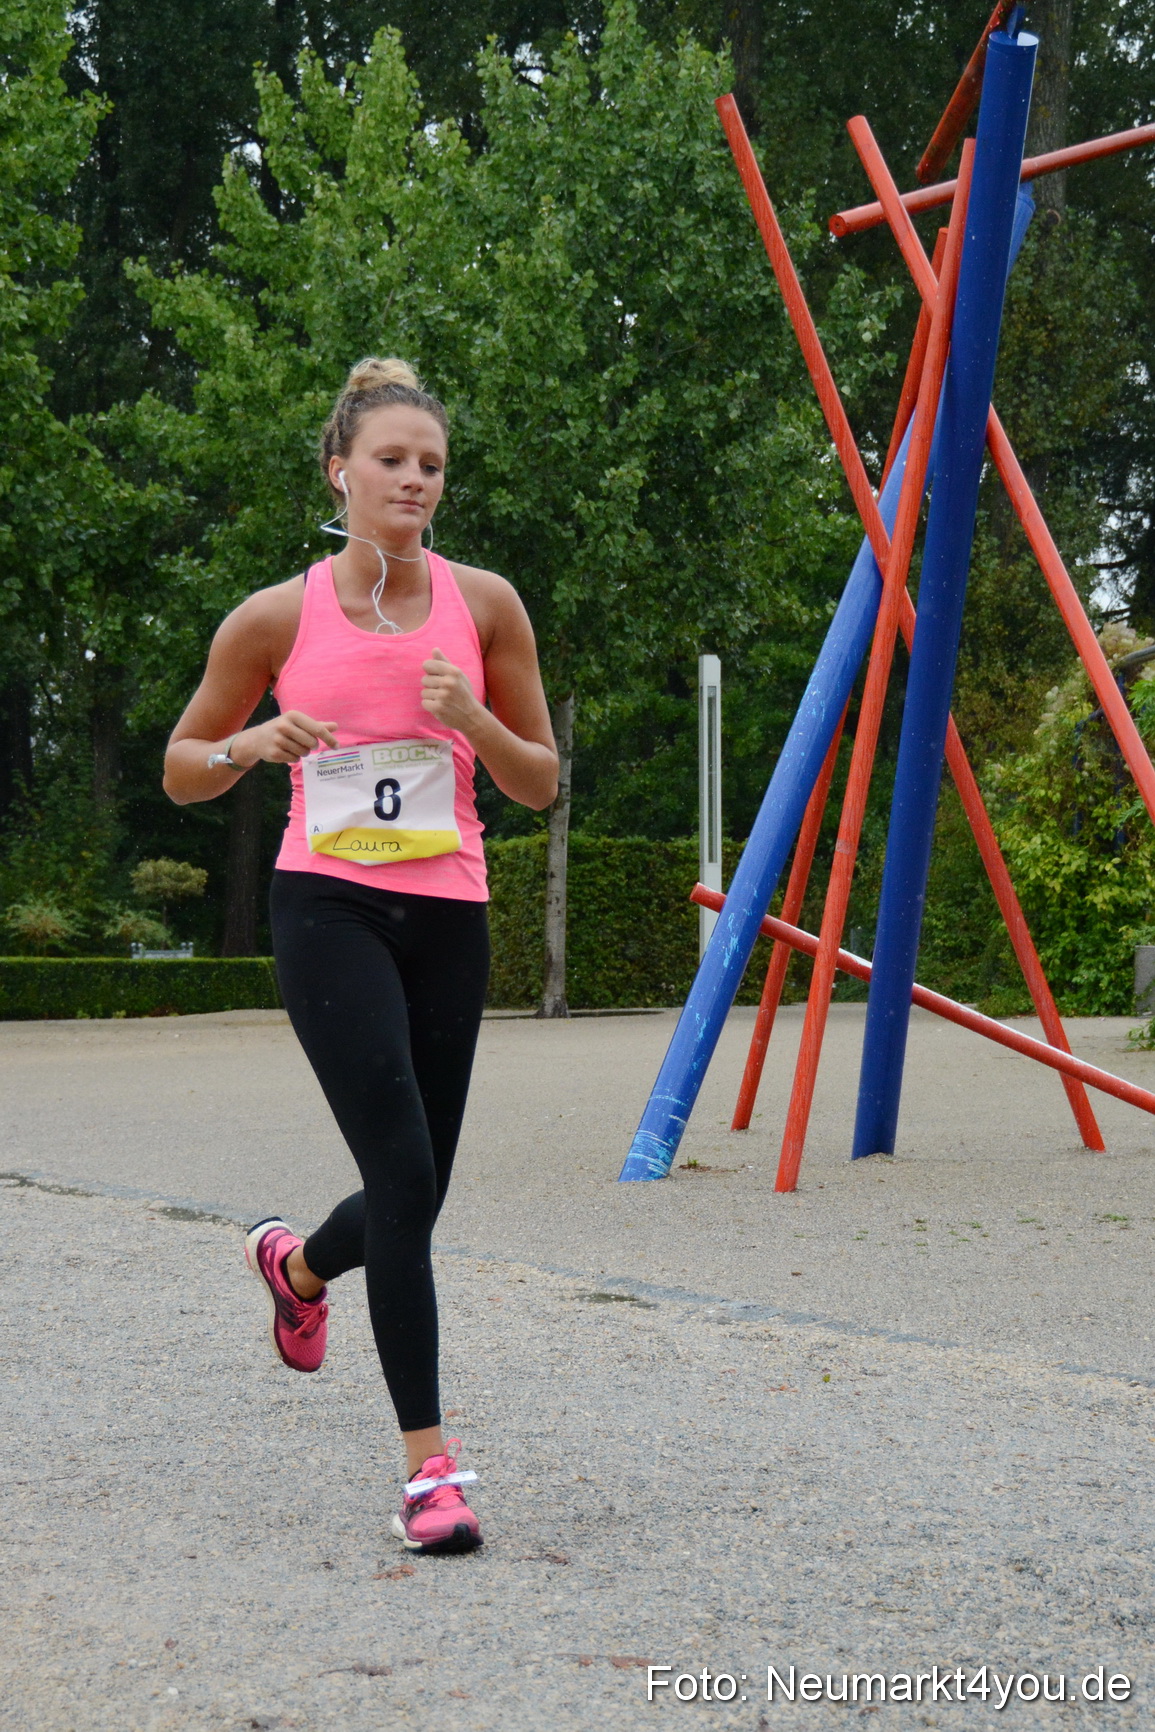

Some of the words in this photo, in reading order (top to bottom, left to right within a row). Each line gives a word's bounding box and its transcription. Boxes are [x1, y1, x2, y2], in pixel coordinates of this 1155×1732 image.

[372, 744, 442, 765] BOCK
[316, 763, 365, 777] NeuerMarkt
[373, 778, 401, 821] 8
[332, 830, 402, 852] Laura
